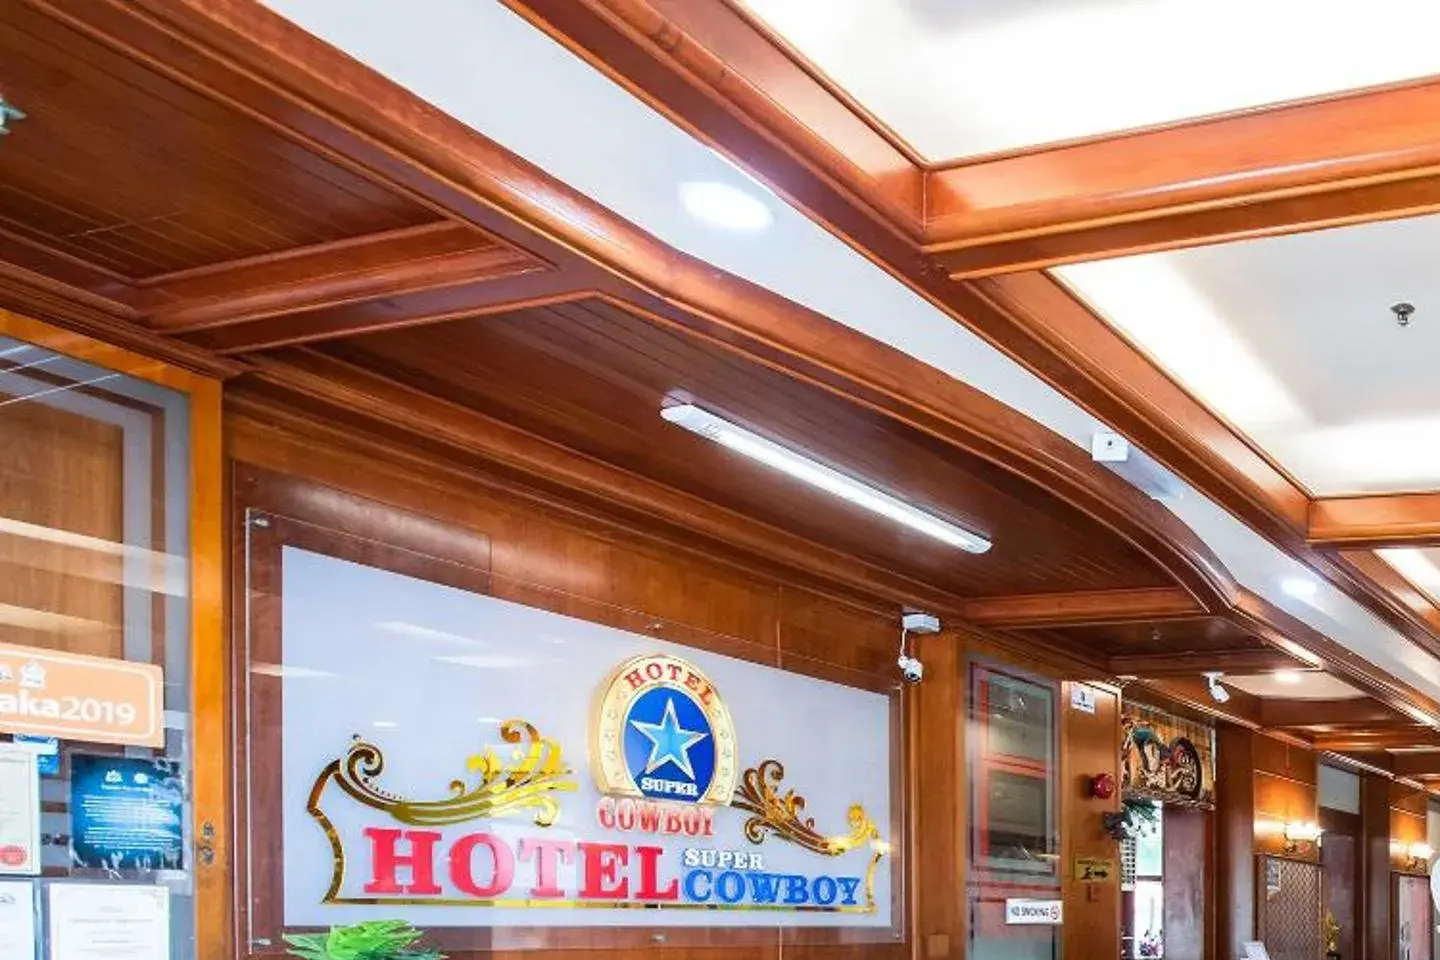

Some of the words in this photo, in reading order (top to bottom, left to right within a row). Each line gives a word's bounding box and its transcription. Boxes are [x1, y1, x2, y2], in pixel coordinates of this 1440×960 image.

[624, 662, 713, 705] HOTEL
[640, 777, 699, 797] SUPER
[598, 799, 714, 836] COWBOY
[363, 827, 680, 900] HOTEL
[684, 848, 764, 869] SUPER
[684, 869, 860, 905] COWBOY
